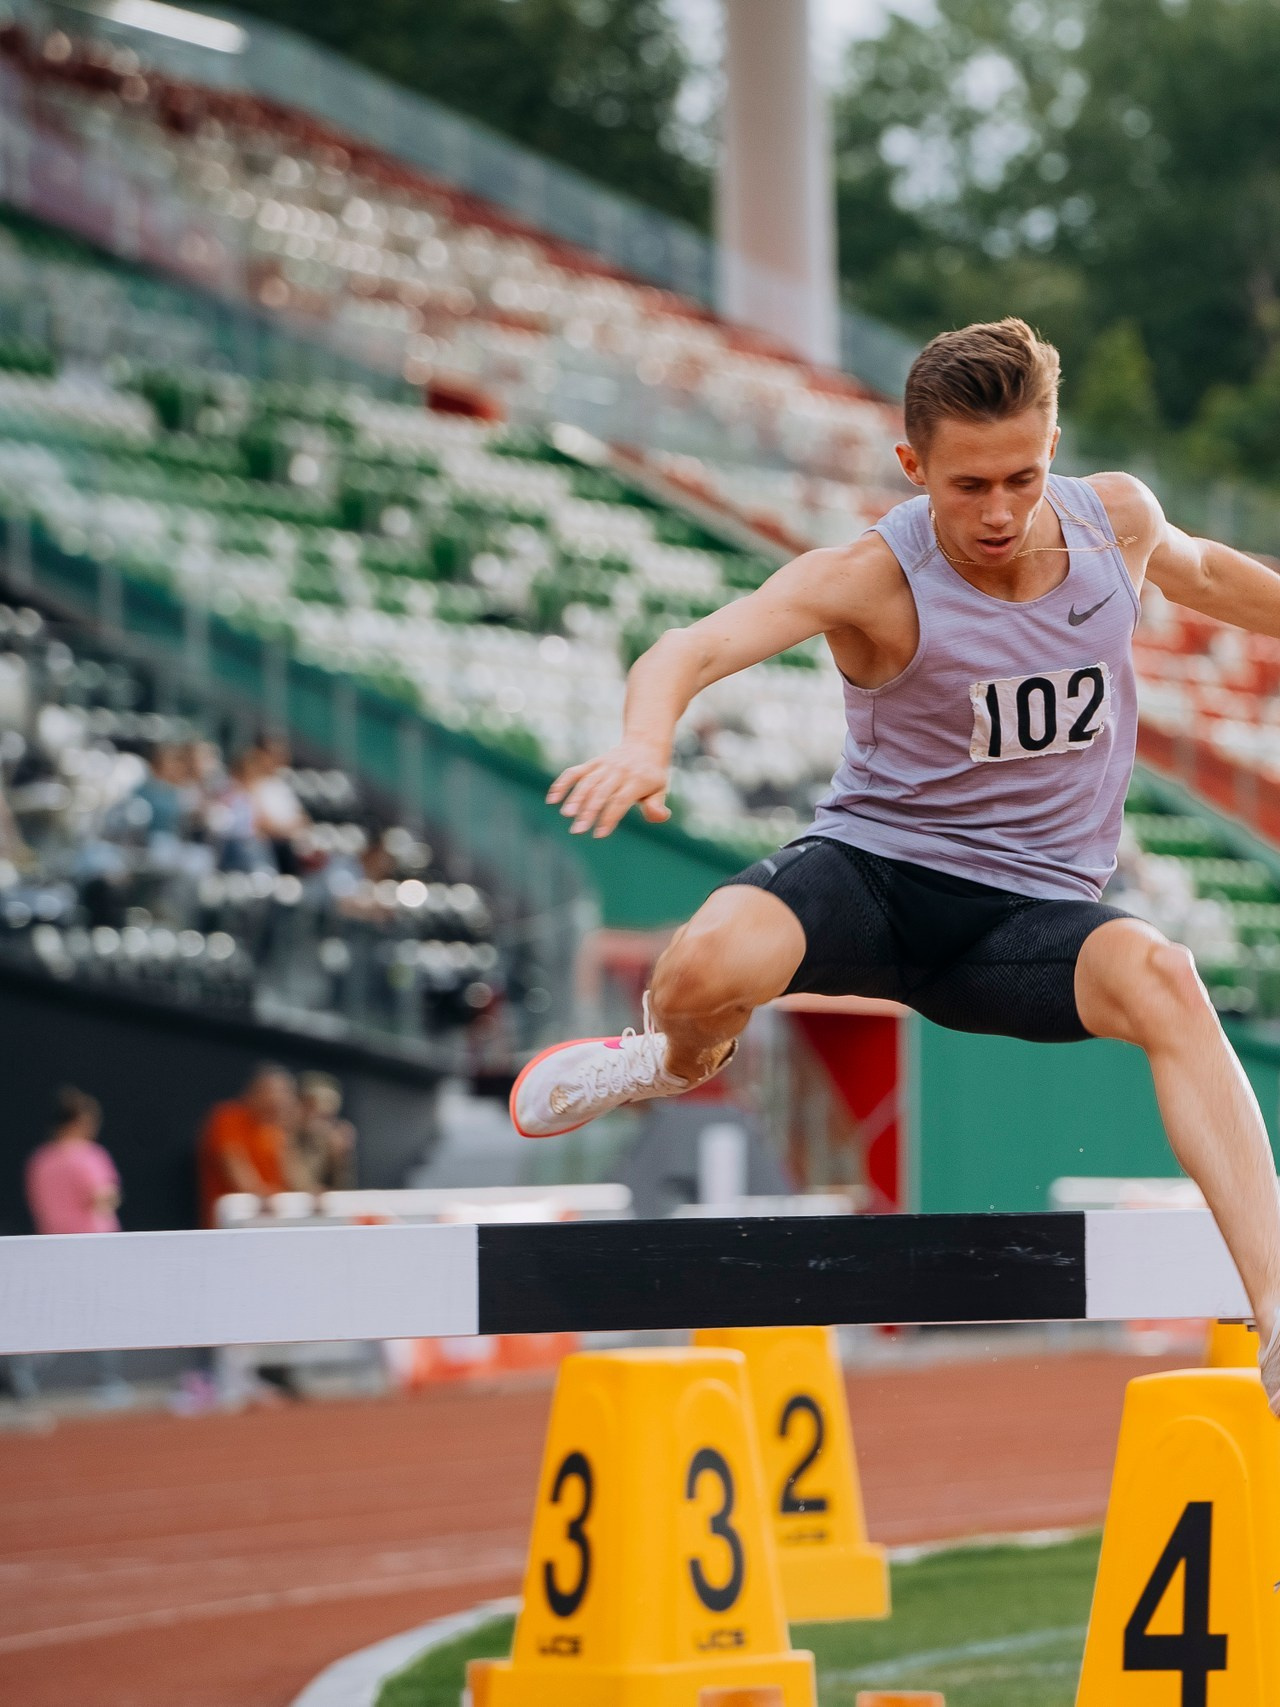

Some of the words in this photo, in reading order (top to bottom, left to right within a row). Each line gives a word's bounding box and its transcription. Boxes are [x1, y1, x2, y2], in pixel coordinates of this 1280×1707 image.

[985, 667, 1104, 758] 102
[543, 1450, 595, 1618] 3
[686, 1447, 746, 1613] 3
[778, 1395, 829, 1516] 2
[1123, 1501, 1228, 1707] 4
